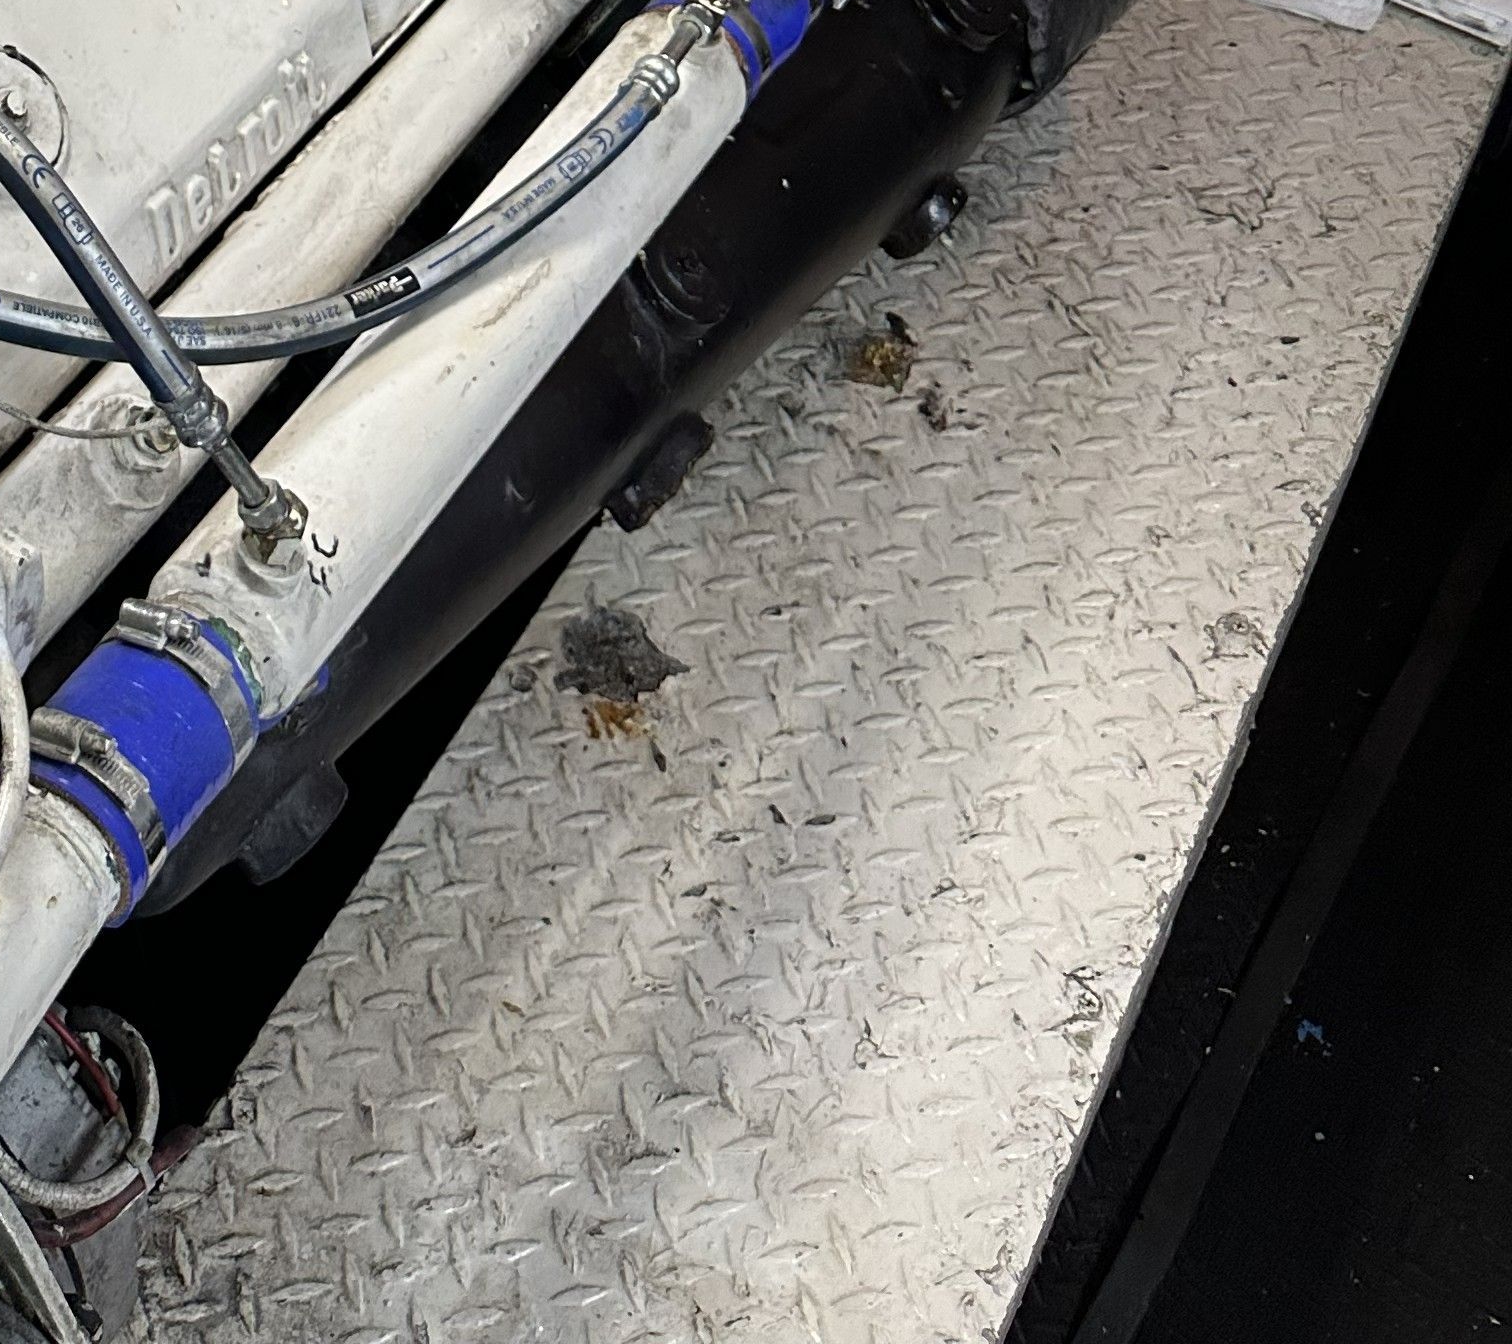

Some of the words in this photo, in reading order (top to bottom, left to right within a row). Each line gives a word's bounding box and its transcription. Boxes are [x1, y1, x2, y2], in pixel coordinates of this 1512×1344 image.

[144, 50, 327, 266] Detroit
[94, 253, 124, 292] MADE
[119, 288, 133, 308] IN
[350, 274, 414, 307] Parker
